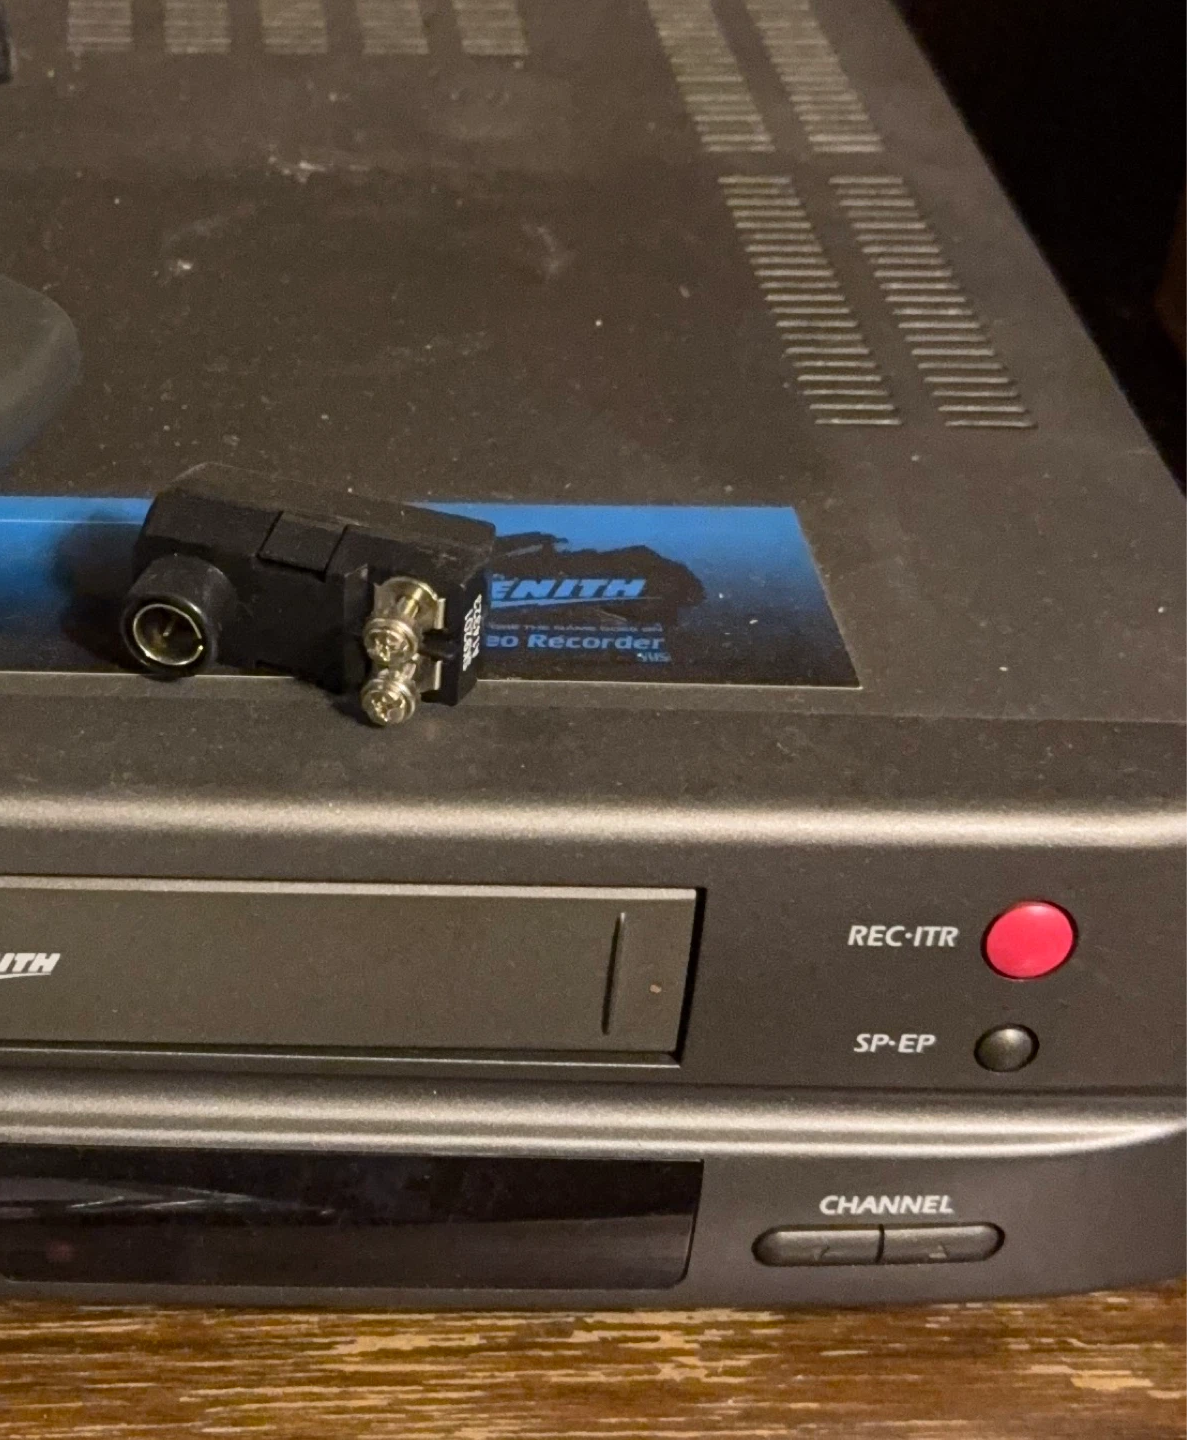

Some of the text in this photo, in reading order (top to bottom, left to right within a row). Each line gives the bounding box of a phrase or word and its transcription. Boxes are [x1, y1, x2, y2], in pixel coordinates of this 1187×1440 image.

[491, 578, 651, 607] ENITH
[527, 634, 665, 649] Recorder
[819, 1195, 954, 1215] CHANNEL
